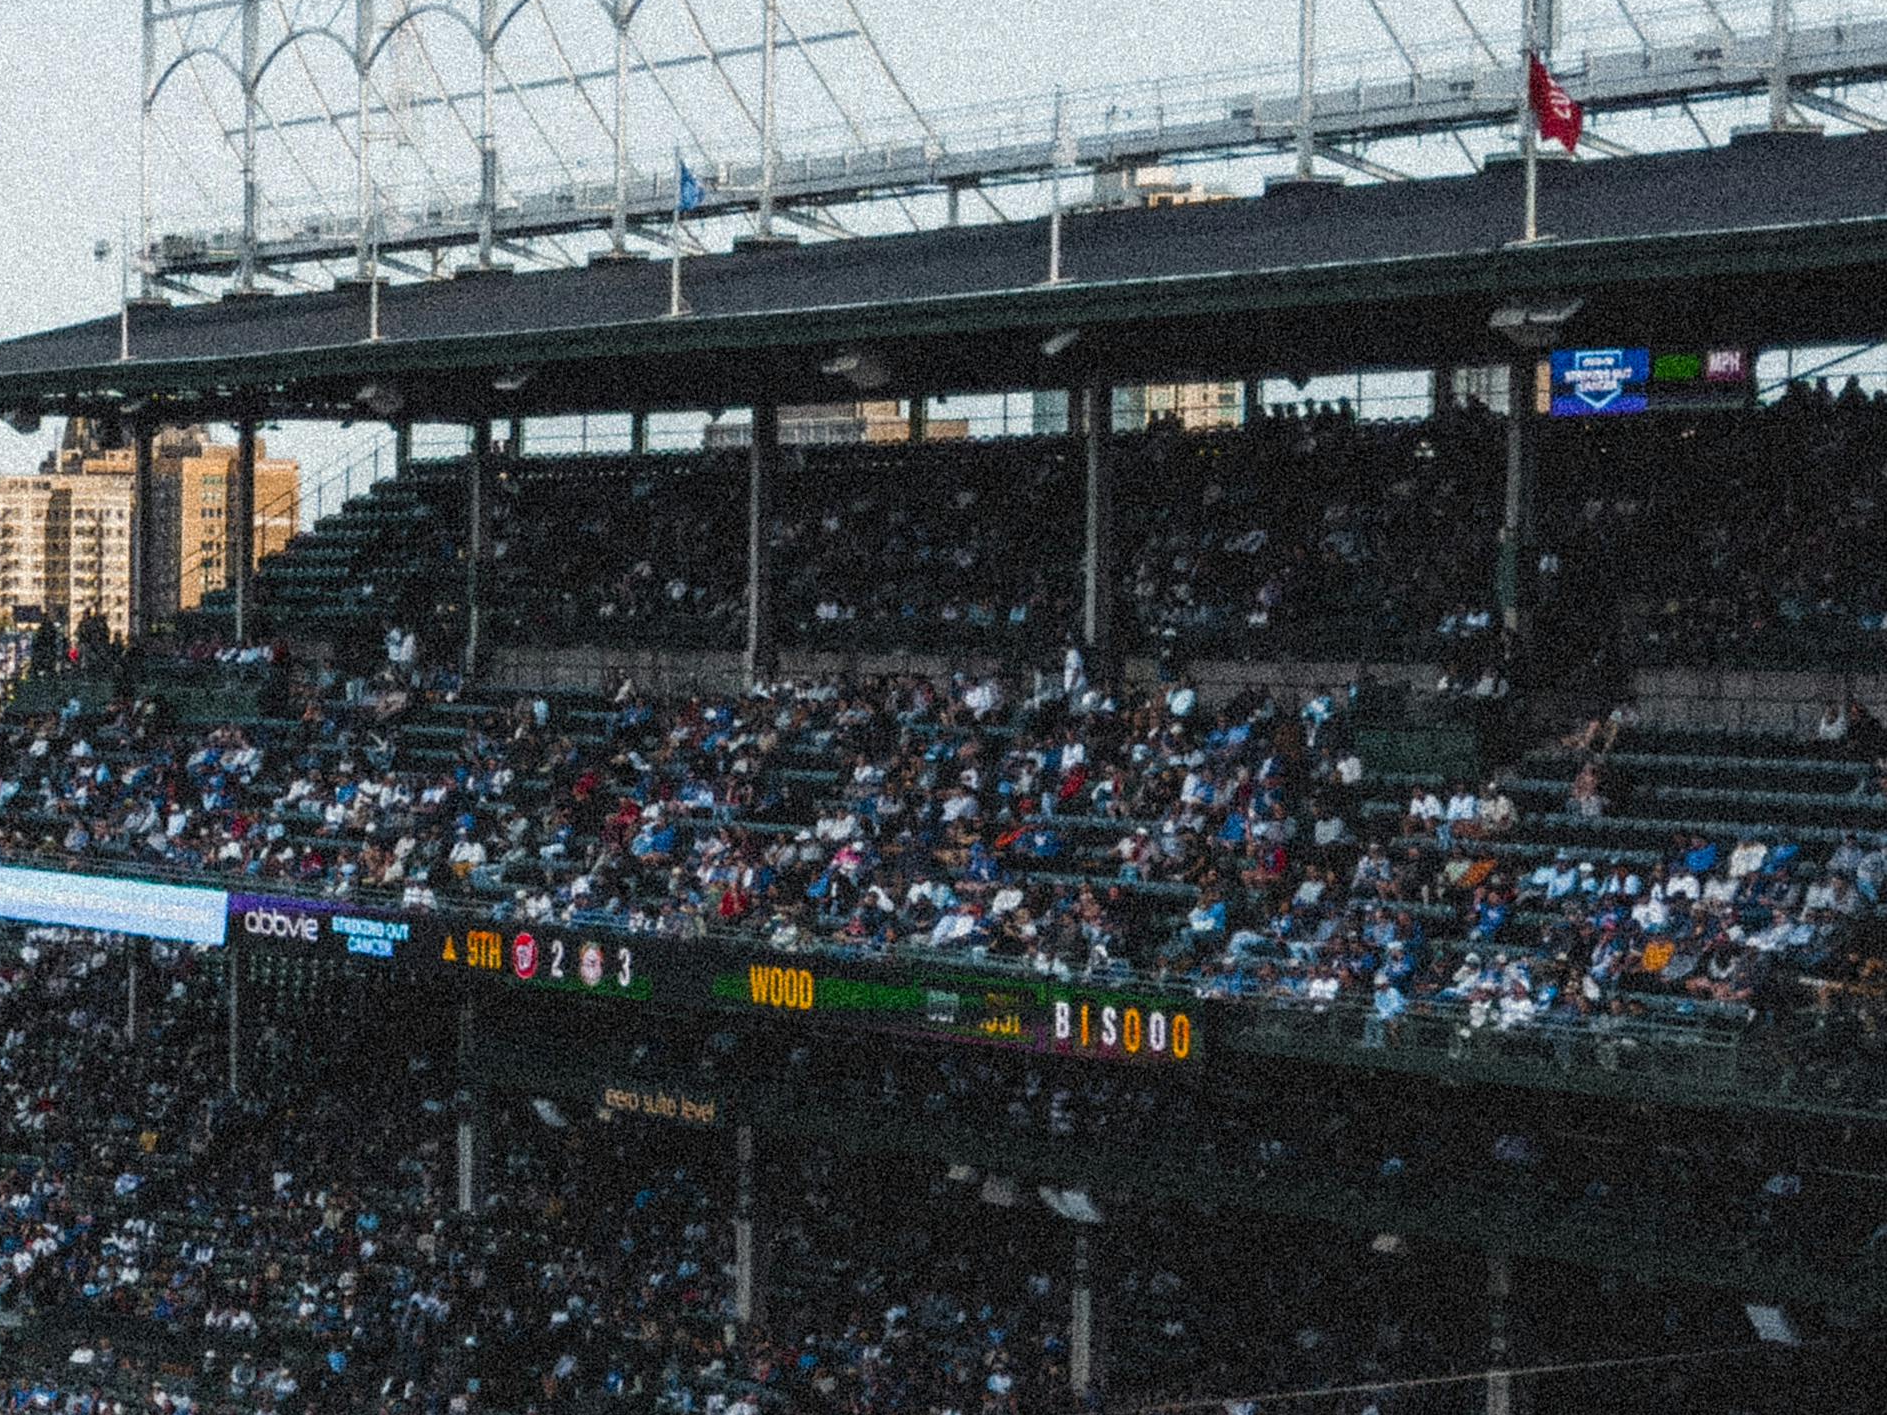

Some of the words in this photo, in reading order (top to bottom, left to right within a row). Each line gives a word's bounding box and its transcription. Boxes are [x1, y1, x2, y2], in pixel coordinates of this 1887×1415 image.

[244, 906, 320, 942] abbvie
[466, 930, 502, 970] 9TH
[551, 939, 564, 979] 2
[618, 947, 632, 988] 3
[748, 965, 815, 1010] WOOD
[1055, 1001, 1071, 1039] B
[1101, 1005, 1117, 1045] S
